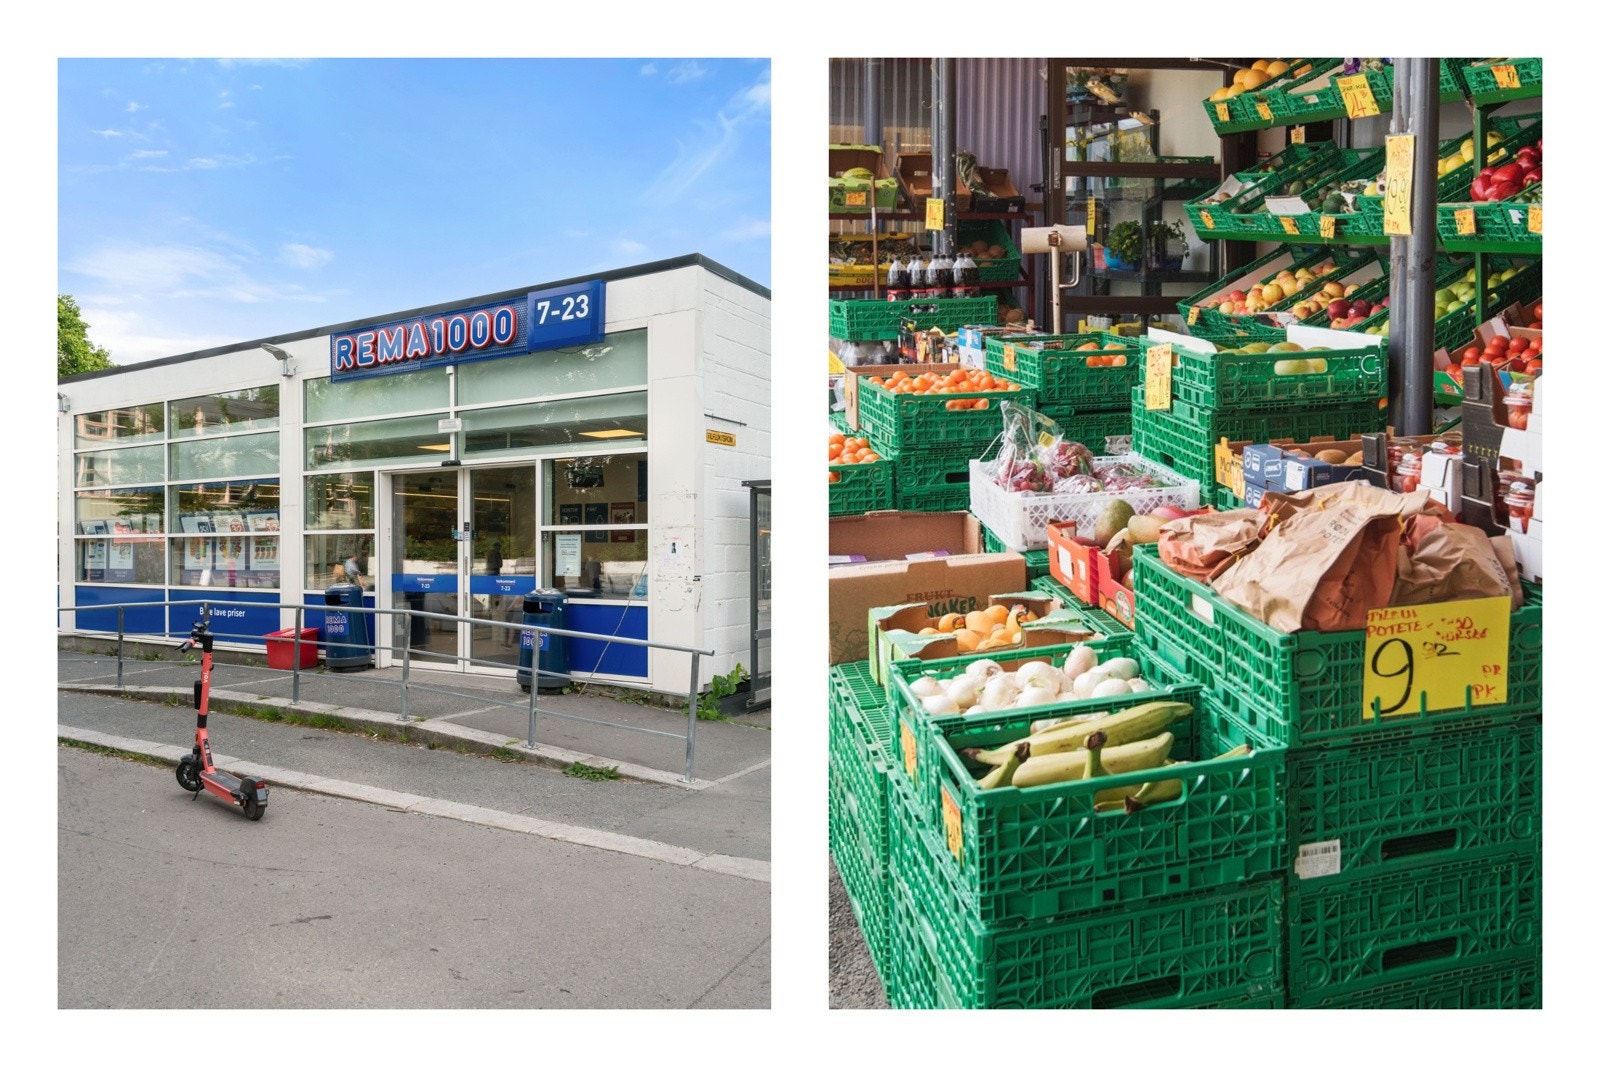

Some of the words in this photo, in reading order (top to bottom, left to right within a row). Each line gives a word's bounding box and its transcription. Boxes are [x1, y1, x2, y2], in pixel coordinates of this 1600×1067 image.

[537, 294, 589, 325] 7-23
[335, 321, 431, 371] REMA
[432, 306, 517, 355] 1000
[906, 589, 952, 602] FRUKT
[200, 607, 213, 615] Be
[214, 608, 227, 616] lave
[227, 609, 246, 618] priser
[1371, 638, 1413, 714] 9
